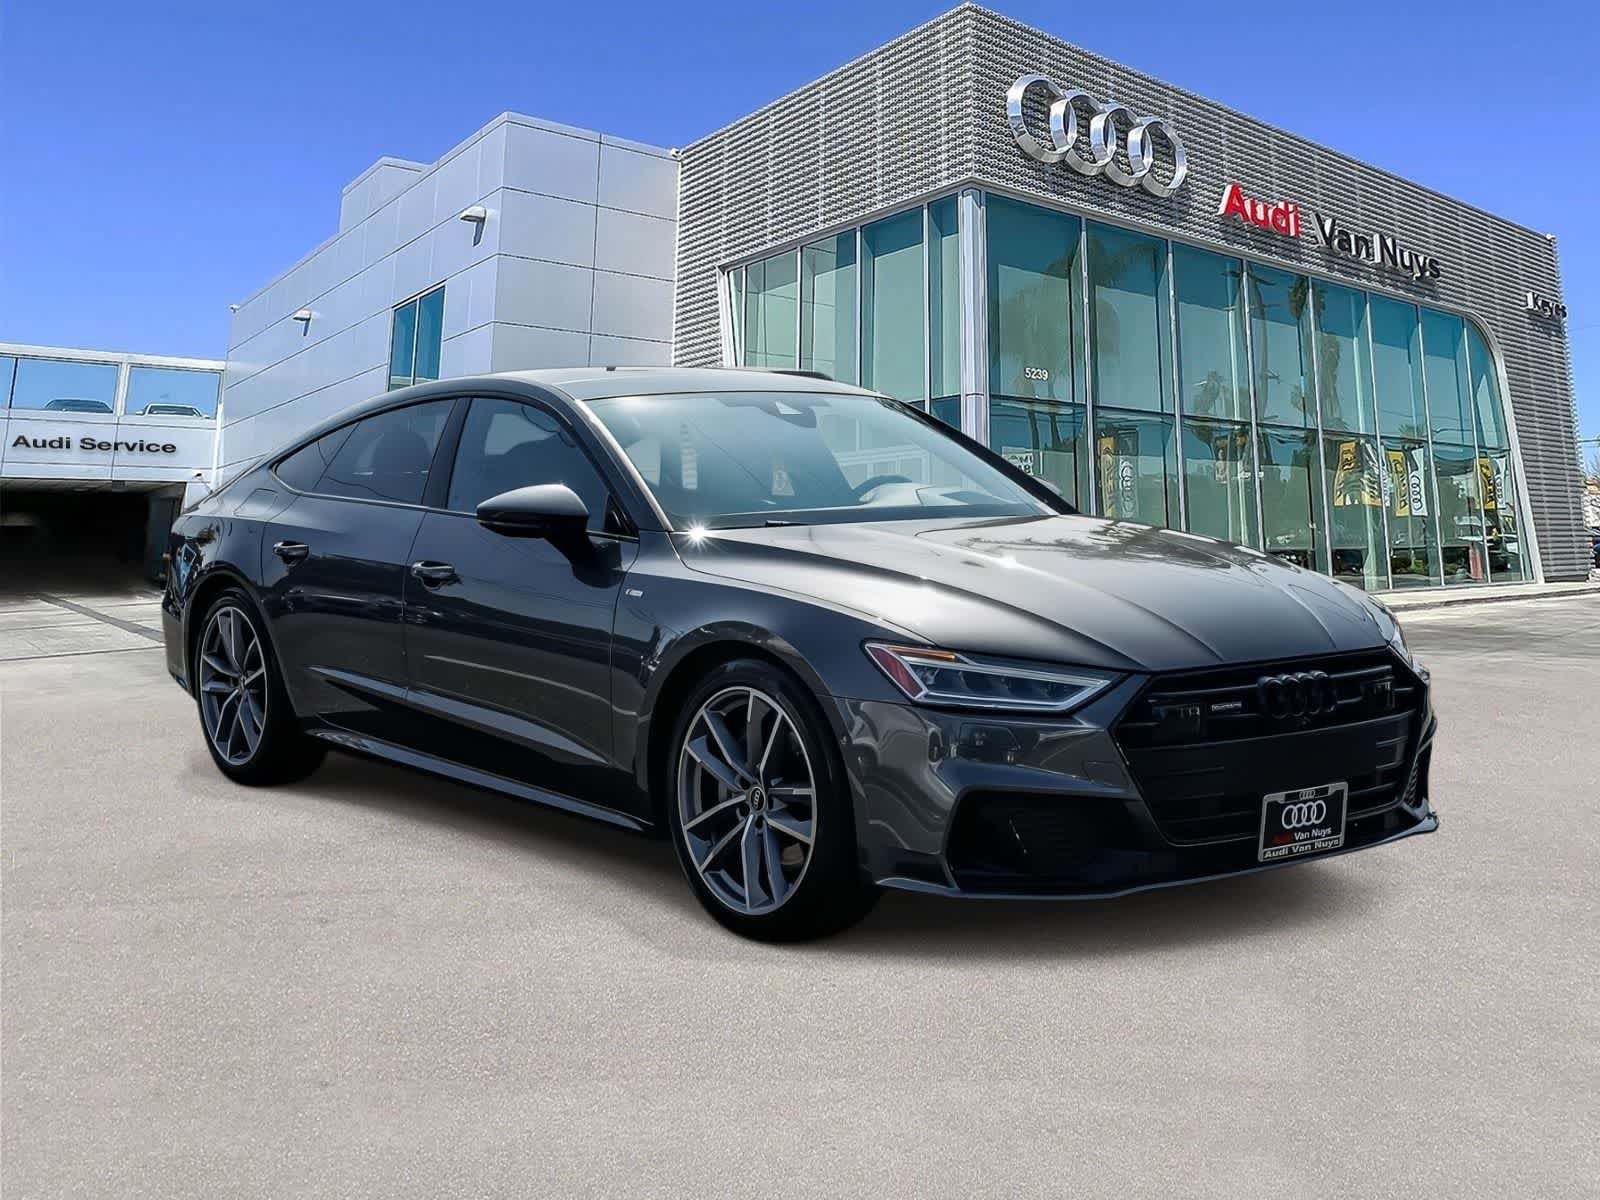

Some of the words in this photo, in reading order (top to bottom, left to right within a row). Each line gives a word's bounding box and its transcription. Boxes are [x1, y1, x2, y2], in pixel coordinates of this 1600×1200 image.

[1219, 182, 1302, 238] Audi
[1311, 211, 1370, 258] Van
[1373, 232, 1441, 281] Nuys
[1024, 367, 1049, 381] 5239
[12, 434, 71, 450] Audi
[79, 437, 177, 454] Service
[1294, 832, 1310, 841] Van
[1312, 827, 1332, 838] Nuys
[1264, 846, 1289, 859] Audi
[1292, 843, 1312, 853] Van
[1314, 838, 1339, 850] Nuys
